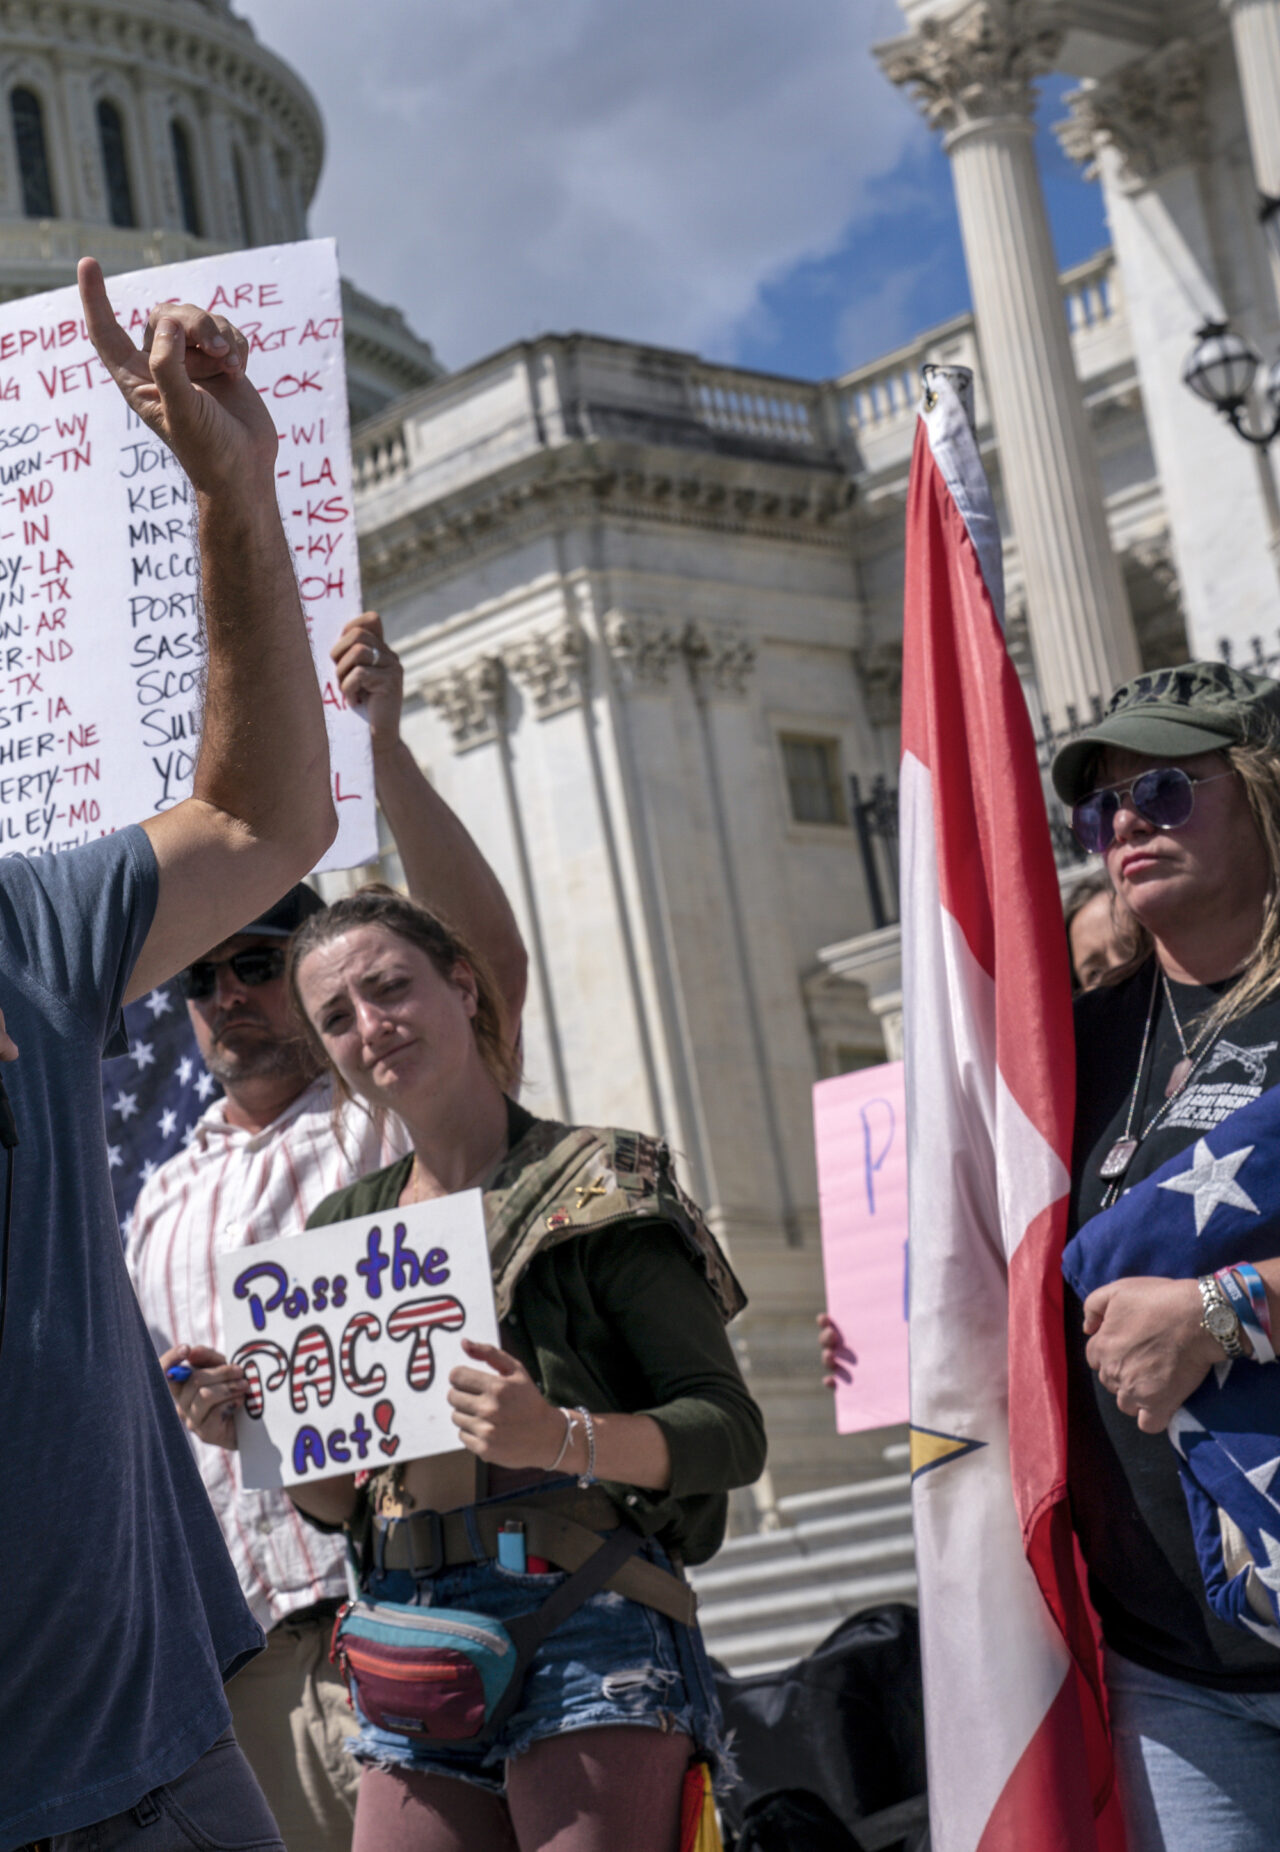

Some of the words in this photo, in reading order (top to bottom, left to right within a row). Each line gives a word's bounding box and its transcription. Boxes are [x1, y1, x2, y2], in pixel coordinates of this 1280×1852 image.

[206, 282, 283, 313] ARE
[298, 318, 342, 346] ACT
[232, 1260, 348, 1331] Pass
[355, 1221, 451, 1300] the
[230, 1294, 466, 1420] PACT
[292, 1398, 401, 1475] Act!
